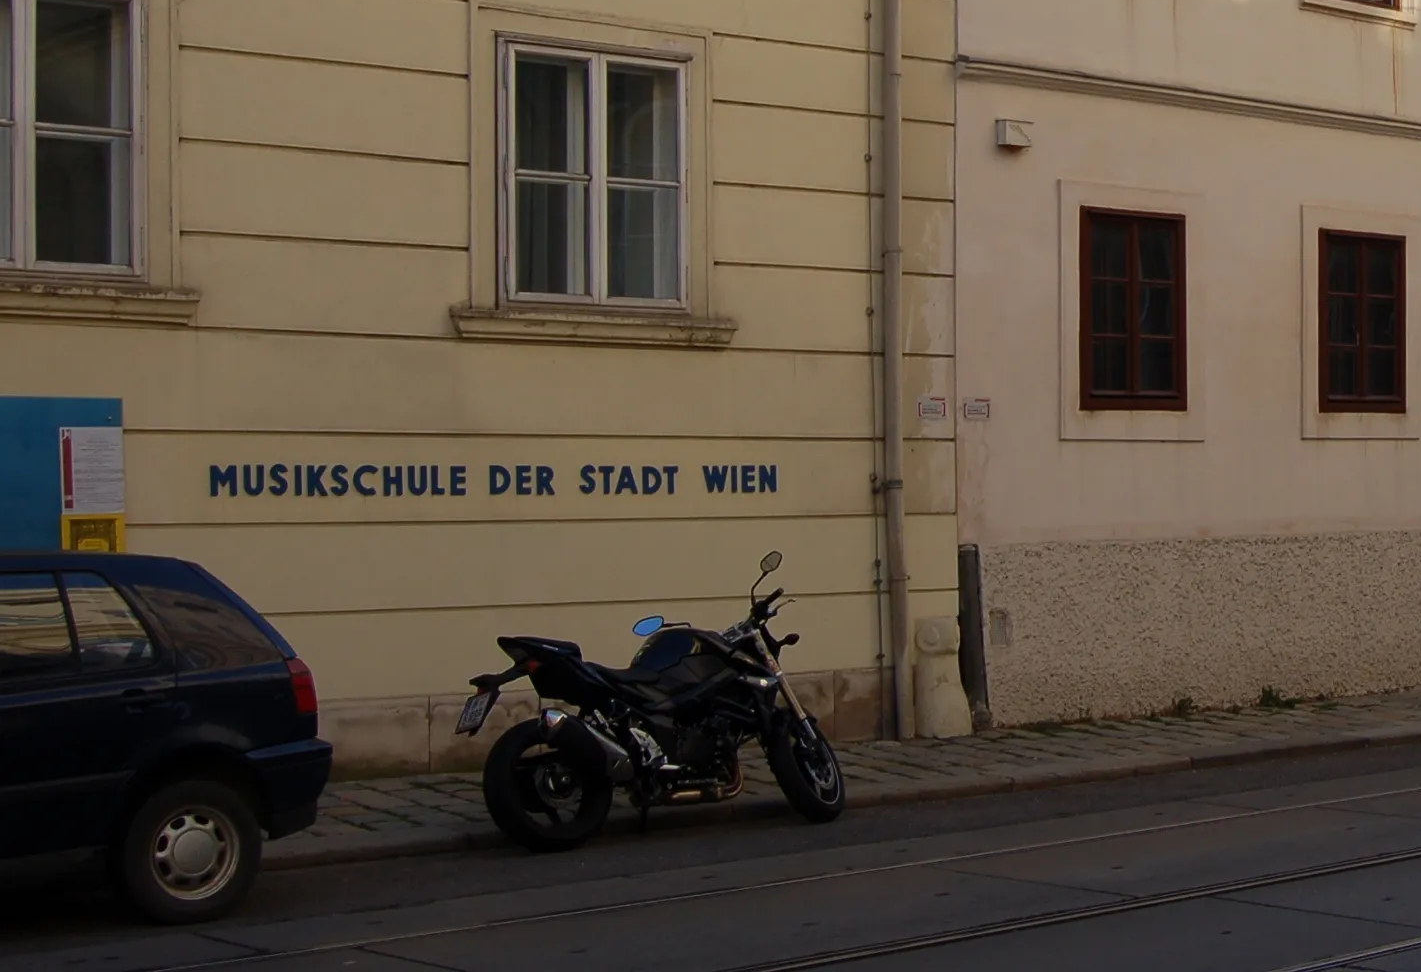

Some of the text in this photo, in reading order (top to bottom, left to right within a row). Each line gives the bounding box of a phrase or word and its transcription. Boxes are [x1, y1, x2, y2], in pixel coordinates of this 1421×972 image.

[209, 464, 777, 497] MUSIKSCHULE DER STADT WIEN
